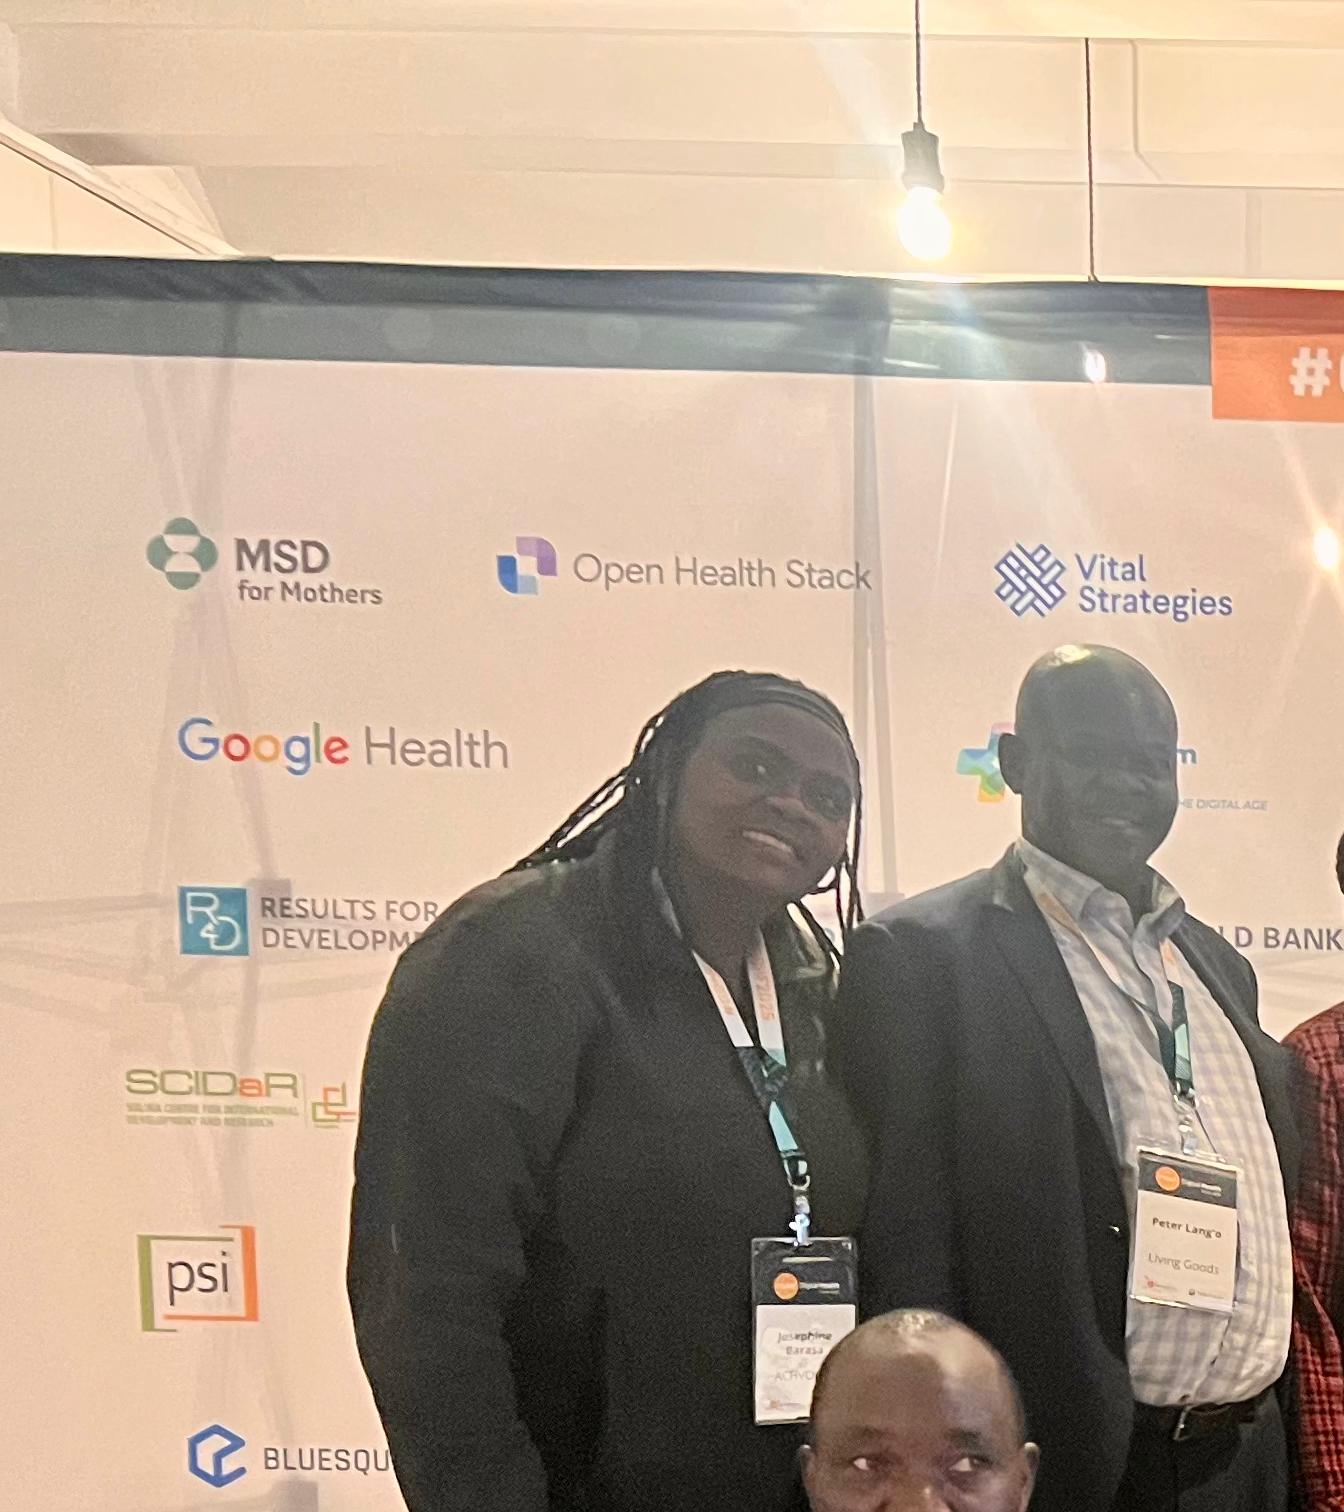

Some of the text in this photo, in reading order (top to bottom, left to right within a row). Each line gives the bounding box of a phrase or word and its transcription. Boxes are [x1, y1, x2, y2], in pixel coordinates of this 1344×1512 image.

[235, 537, 331, 574] MSD
[1076, 553, 1146, 583] Vital
[574, 553, 872, 591] Open Health Stack
[238, 579, 383, 605] for Mothers
[1079, 588, 1233, 621] Strategies
[178, 716, 509, 776] Google Health
[261, 896, 439, 921] RESULTS FOR
[1263, 926, 1344, 950] BANK
[126, 1068, 299, 1098] SCIDaR
[1152, 1217, 1182, 1232] Peter
[166, 1252, 230, 1305] psi
[1148, 1252, 1219, 1276] Living Goods
